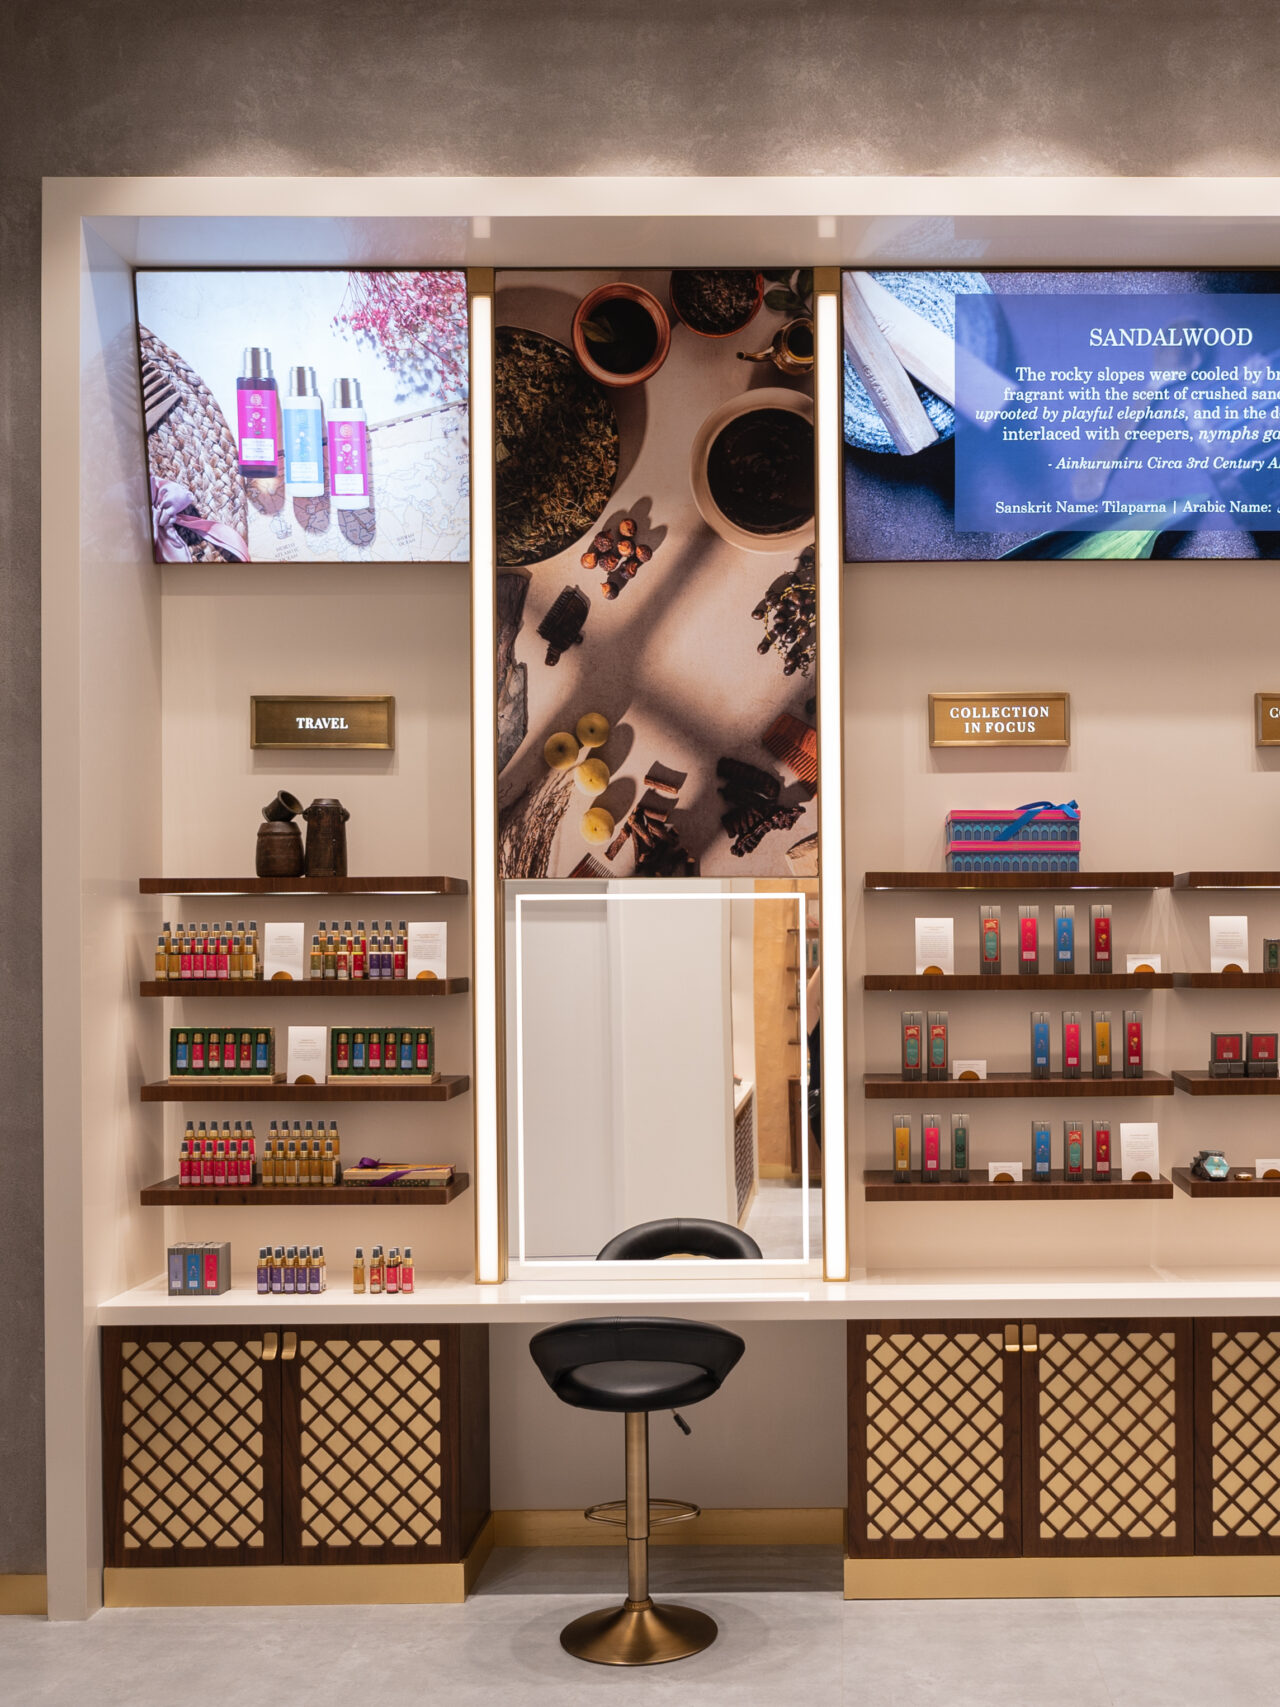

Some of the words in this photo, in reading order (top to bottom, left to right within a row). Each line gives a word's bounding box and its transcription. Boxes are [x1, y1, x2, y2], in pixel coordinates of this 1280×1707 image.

[1089, 327, 1254, 347] SANDALWOOD
[1015, 367, 1046, 382] The
[1050, 367, 1093, 385] rocky
[1098, 367, 1144, 385] slopes
[1149, 370, 1187, 382] were
[1191, 366, 1239, 382] cooled
[1243, 366, 1262, 385] by
[1003, 386, 1064, 404] fragrant
[1068, 386, 1101, 401] with
[1105, 386, 1129, 401] the
[1132, 388, 1170, 401] scent
[1174, 386, 1188, 401] of
[1191, 386, 1248, 401] crushed
[975, 406, 1038, 423] uprooted
[1043, 406, 1059, 423] by
[1062, 406, 1113, 423] playful
[1117, 406, 1189, 423] elephants,
[1193, 406, 1221, 420] and
[1224, 406, 1240, 420] in
[1243, 406, 1266, 420] the
[1002, 426, 1081, 441] interlaced
[1085, 426, 1120, 441] with
[1124, 429, 1194, 445] creepers,
[1198, 425, 1259, 445] nymphs
[1055, 456, 1143, 470] Ainkurumiru
[1147, 456, 1183, 470] Circa
[1186, 456, 1210, 470] 3rd
[1213, 456, 1265, 473] Century
[995, 500, 1053, 514] Sanskrit
[1056, 500, 1098, 514] Name:
[1101, 500, 1167, 516] Tilaparna
[1182, 500, 1226, 513] Arabic
[1229, 500, 1272, 513] Name:
[949, 706, 1050, 719] COLLECTION
[295, 717, 349, 729] TRAVEL
[964, 722, 981, 734] IN
[985, 721, 1036, 733] FOCUS
